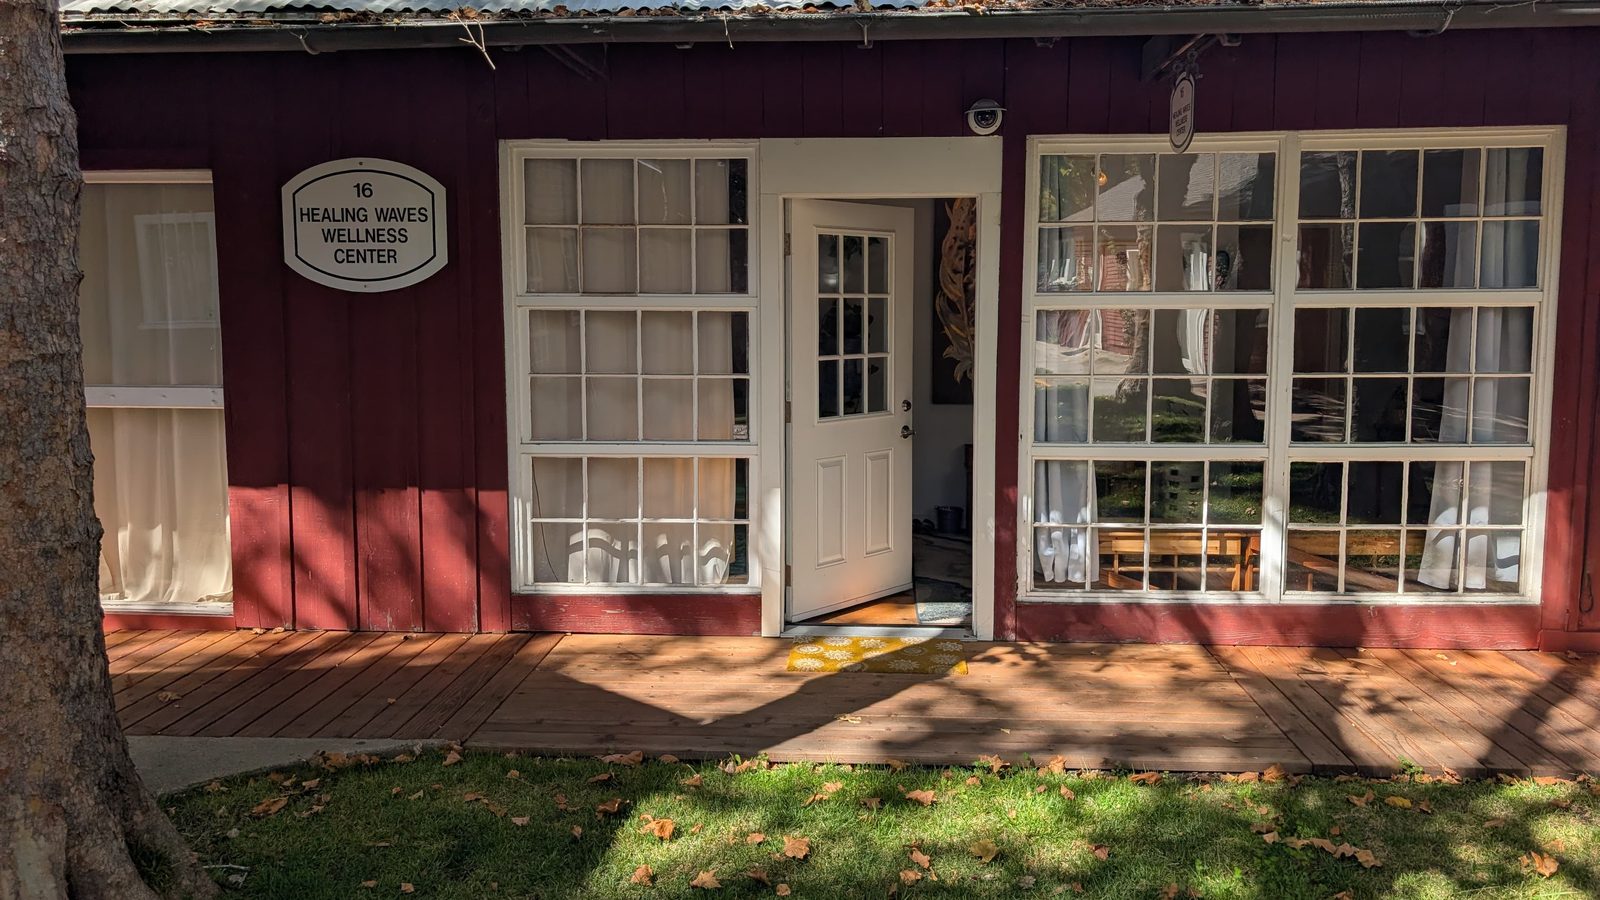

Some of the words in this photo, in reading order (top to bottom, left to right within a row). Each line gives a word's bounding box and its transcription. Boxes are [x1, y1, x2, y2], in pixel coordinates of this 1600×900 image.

[353, 182, 374, 199] 16
[299, 207, 369, 223] HEALING
[374, 207, 429, 223] WAVES
[321, 228, 409, 244] WELLNESS
[333, 248, 398, 265] CENTER
